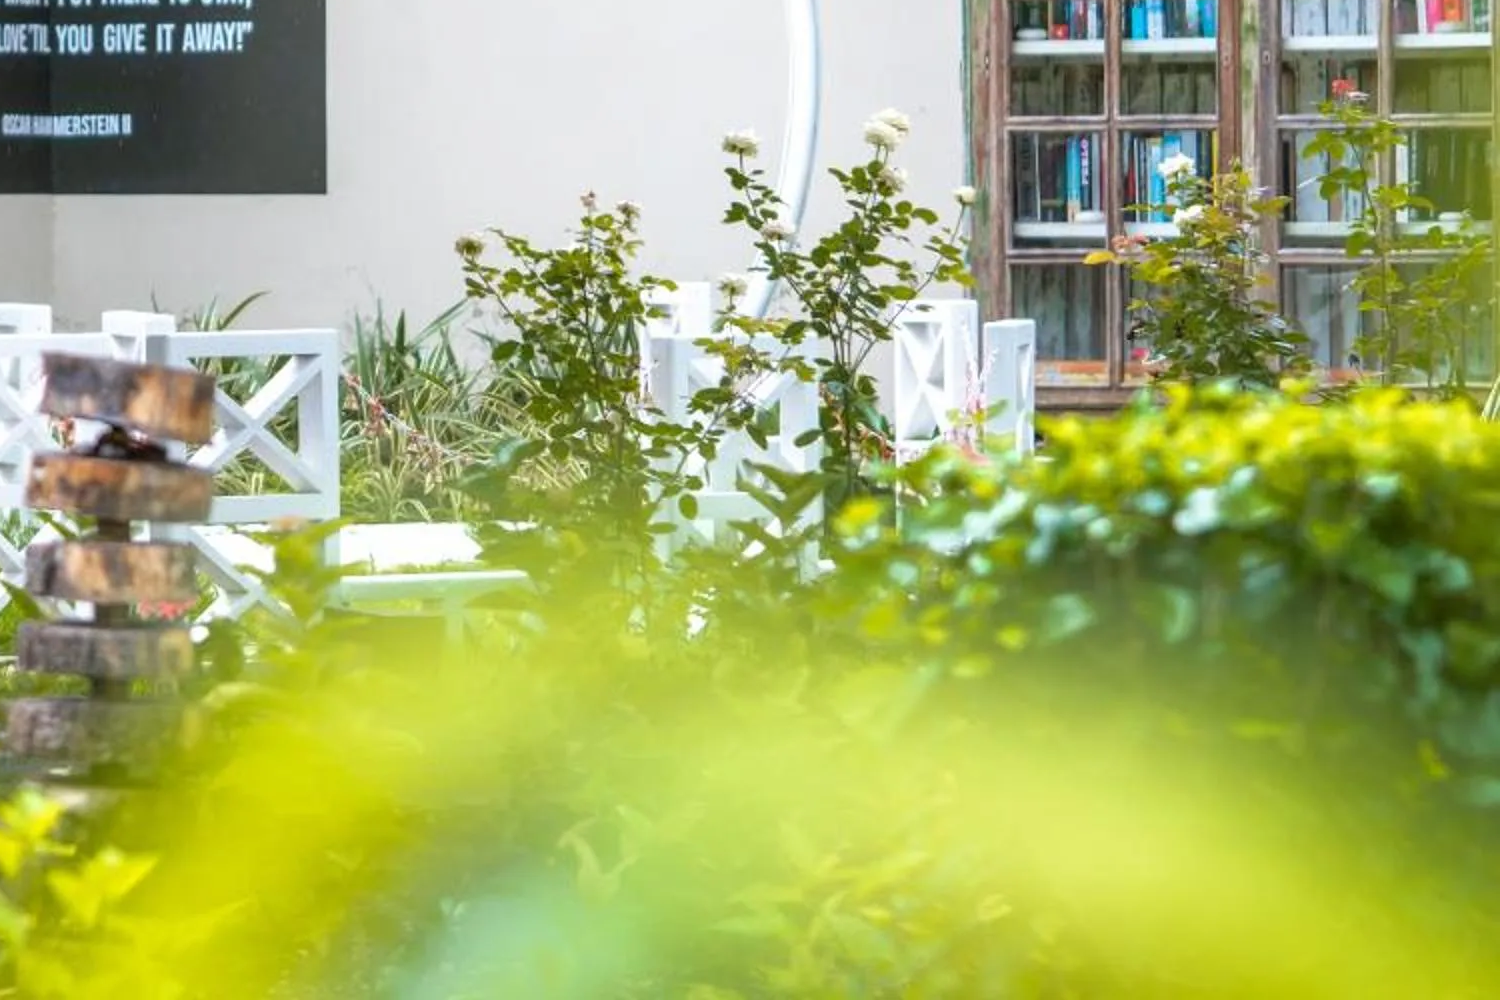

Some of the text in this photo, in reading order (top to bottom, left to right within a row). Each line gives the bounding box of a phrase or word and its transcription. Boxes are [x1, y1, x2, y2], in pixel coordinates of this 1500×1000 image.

[55, 24, 94, 55] YOU
[103, 23, 147, 54] GIVE
[156, 23, 176, 53] IT
